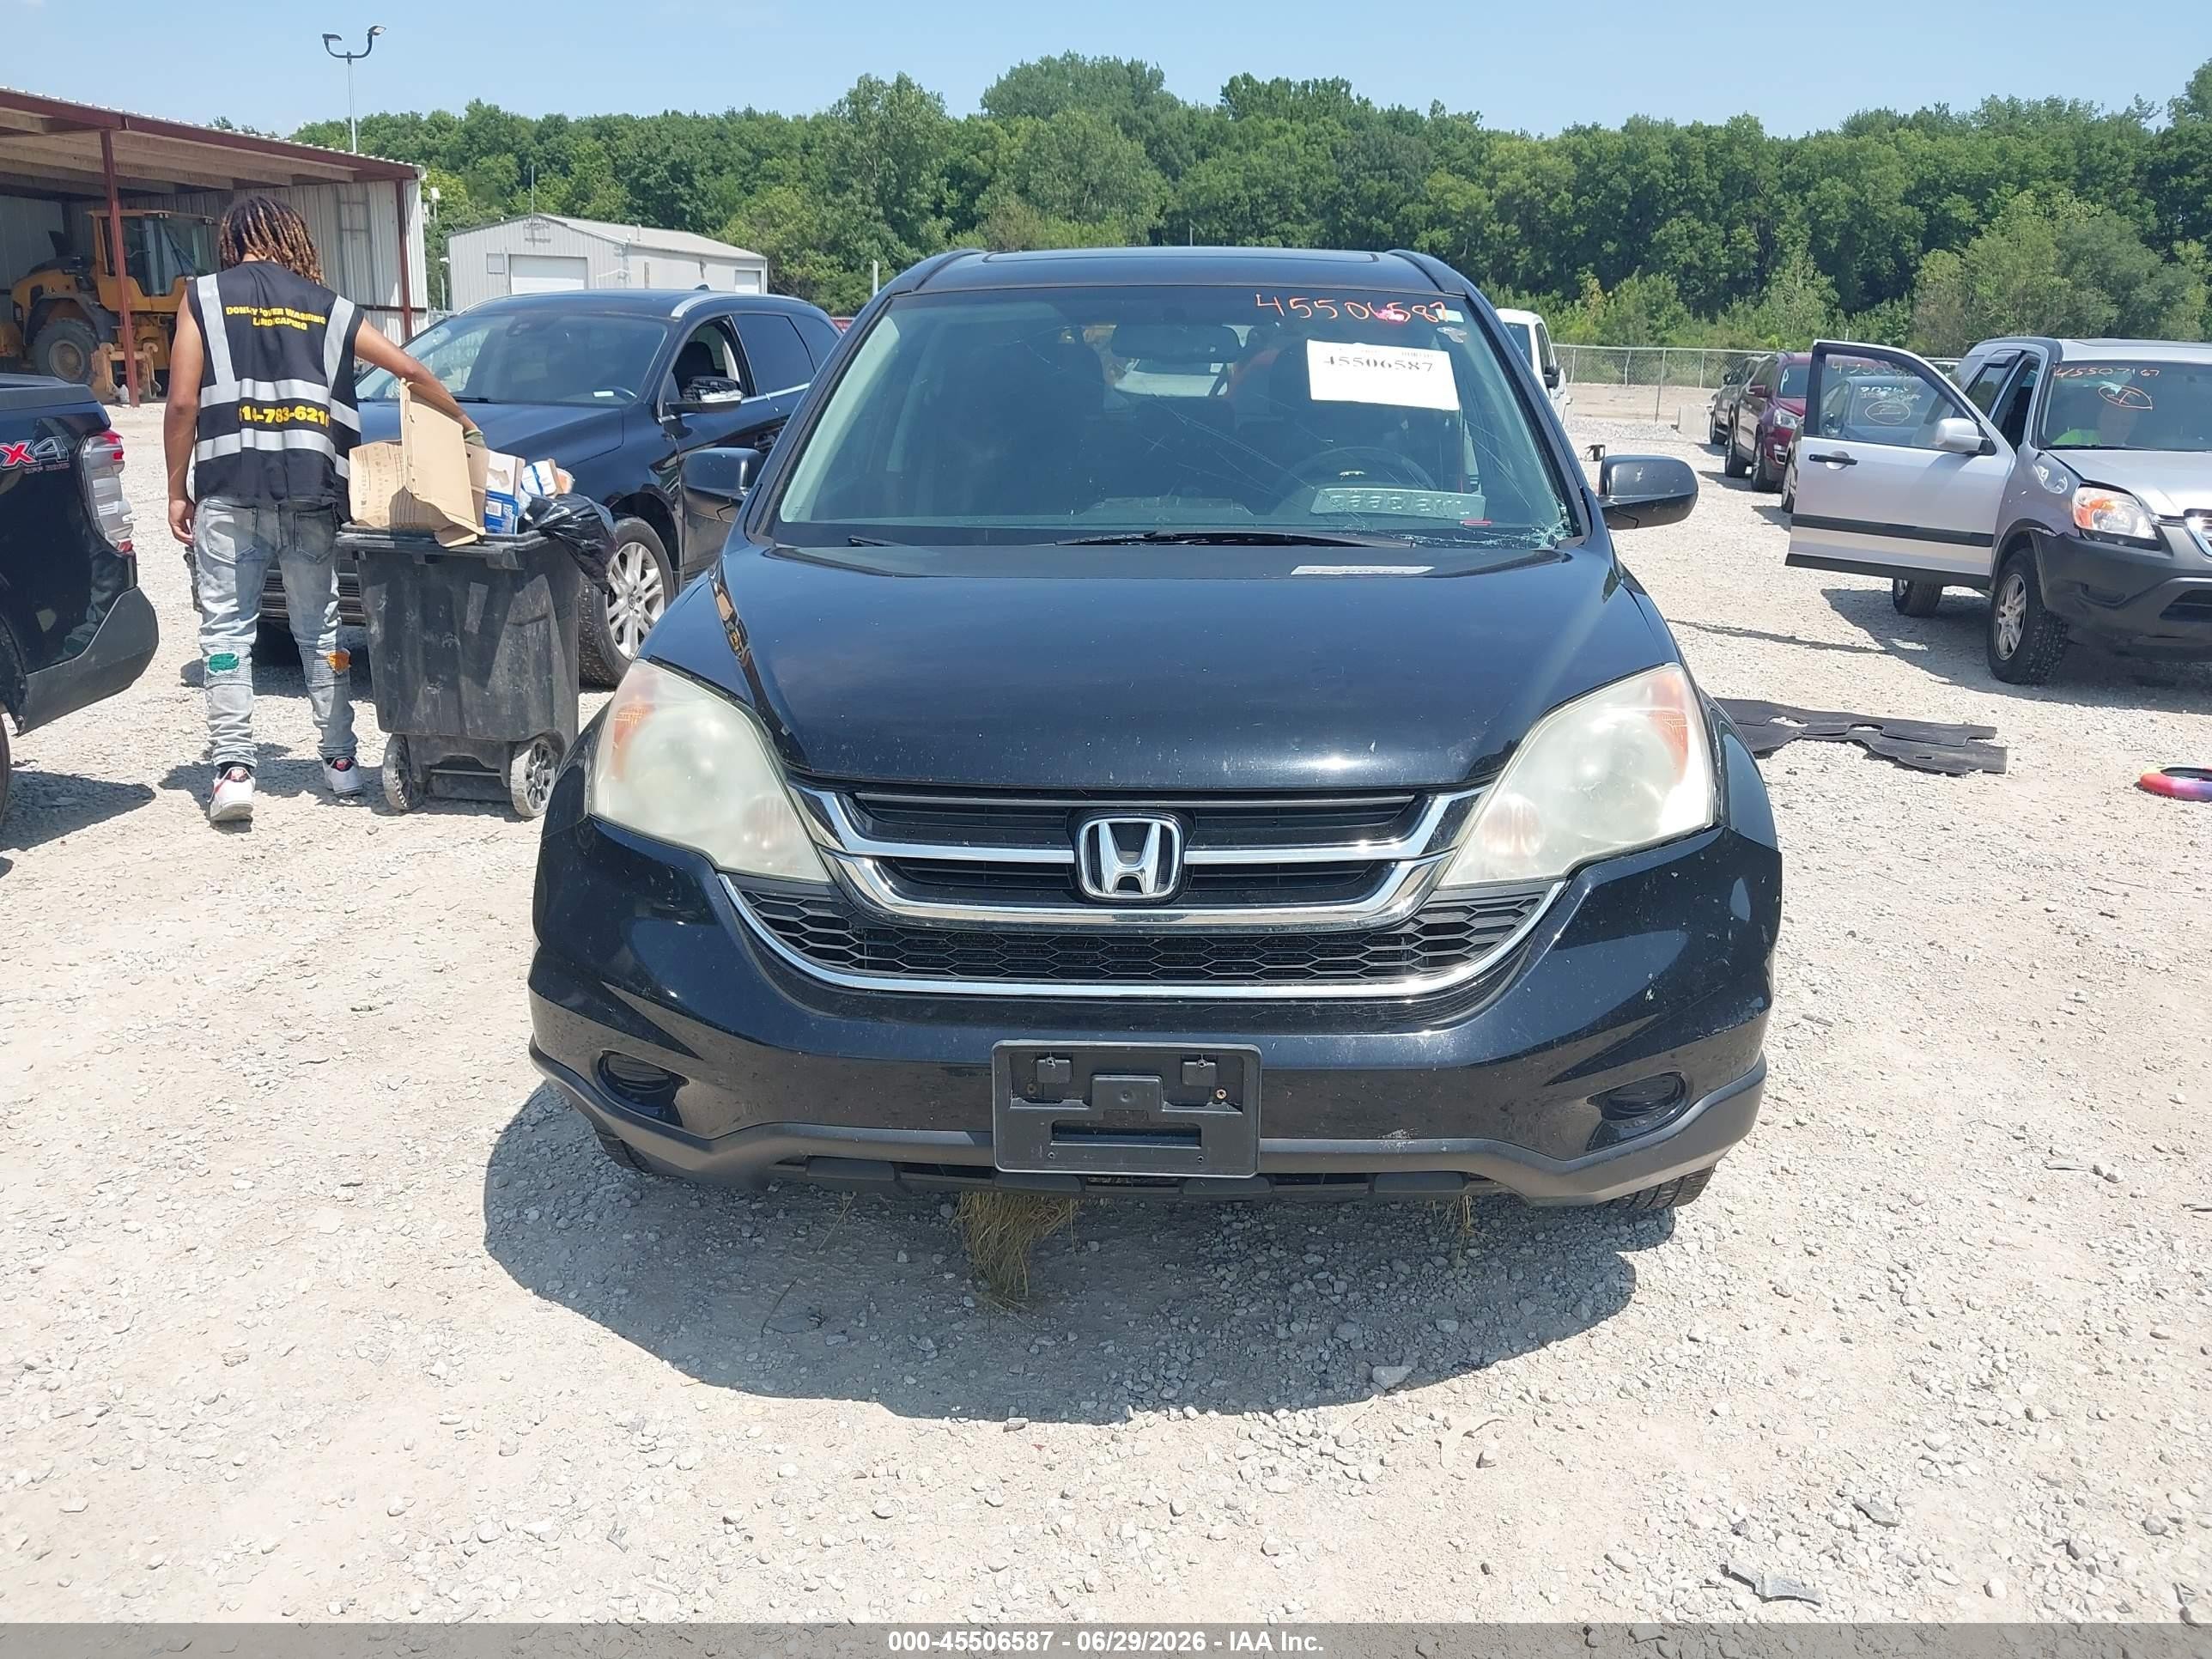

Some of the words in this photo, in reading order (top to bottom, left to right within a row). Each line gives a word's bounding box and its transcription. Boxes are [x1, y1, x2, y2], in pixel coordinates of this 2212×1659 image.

[225, 306, 258, 316] DONLY
[1255, 293, 1449, 323] 45506587
[252, 317, 307, 331] LNDCAPING
[1323, 356, 1434, 373] 45506587
